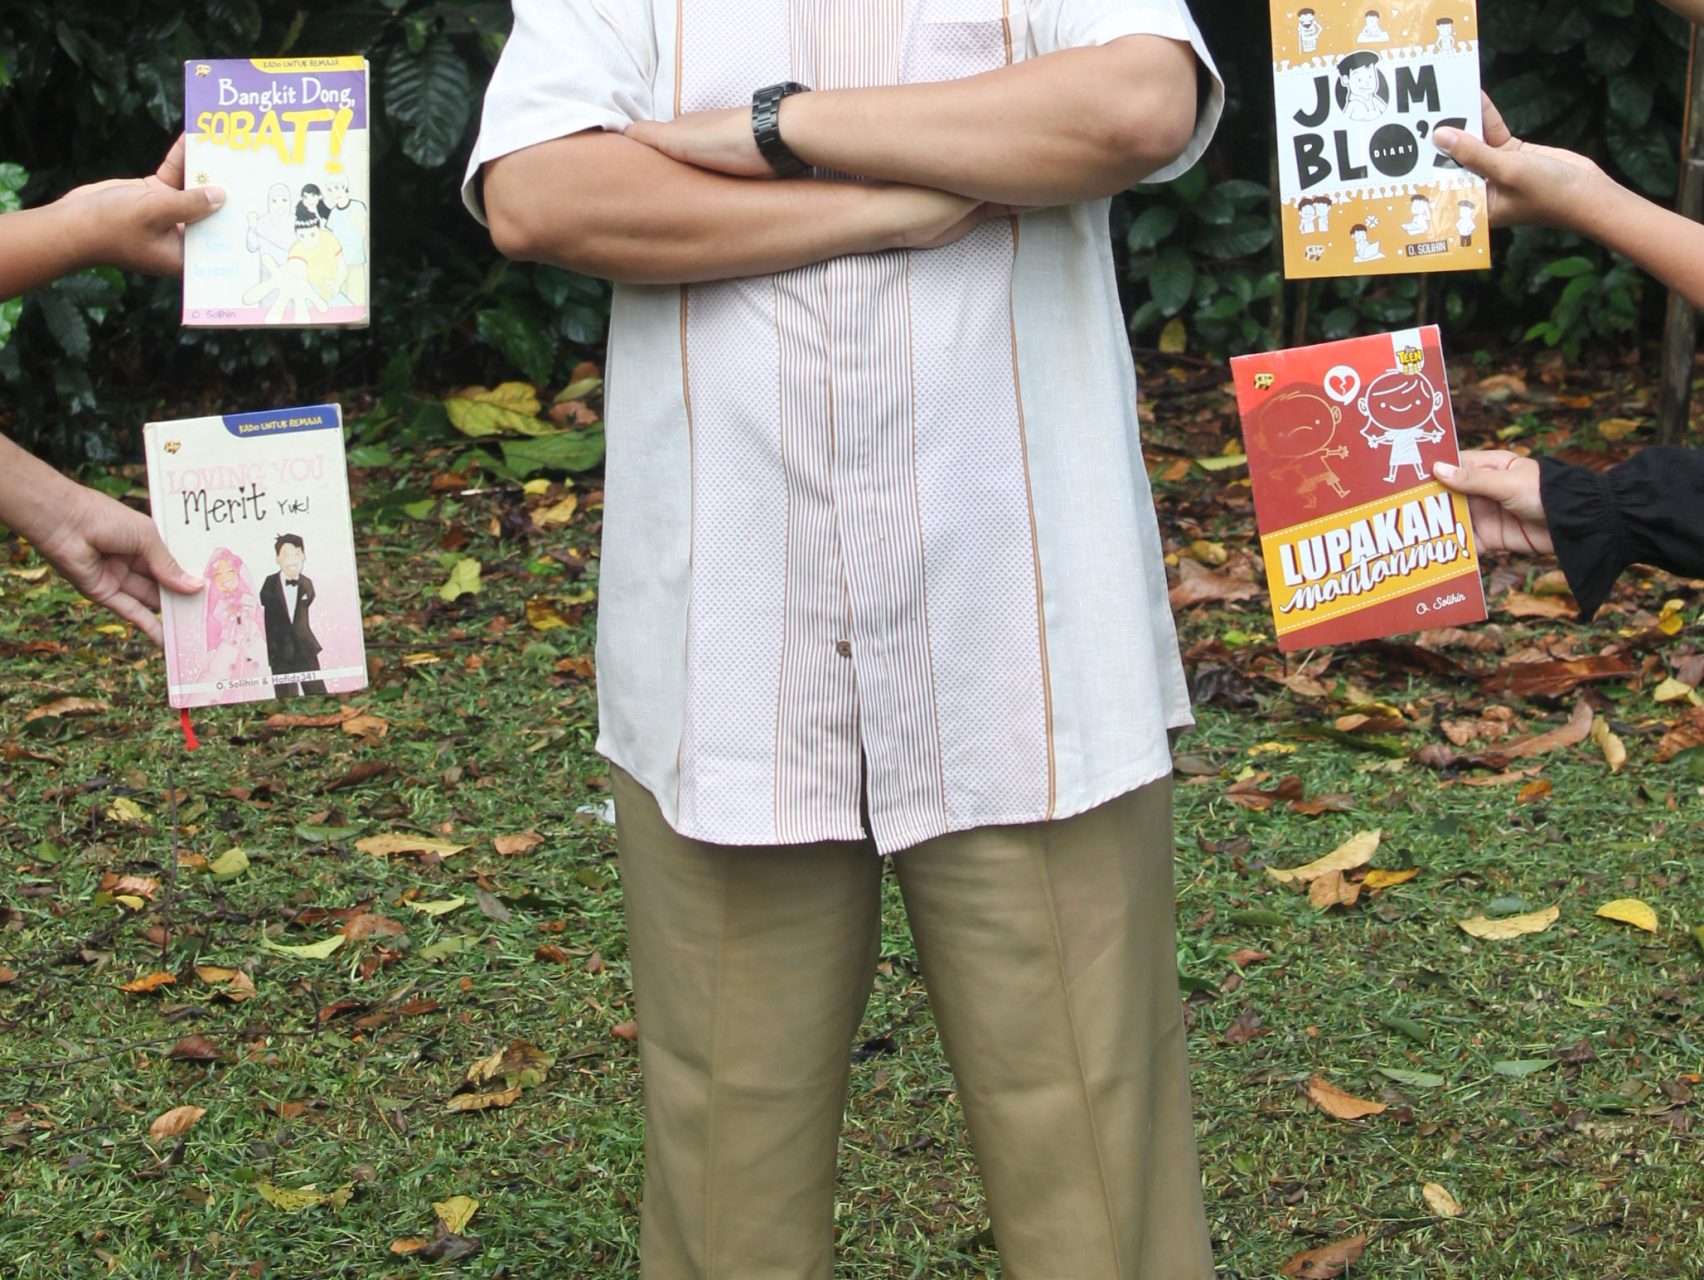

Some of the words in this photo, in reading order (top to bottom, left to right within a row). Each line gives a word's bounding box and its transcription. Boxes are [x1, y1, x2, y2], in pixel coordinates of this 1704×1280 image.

[218, 77, 296, 113] Bangkit
[302, 76, 356, 110] Dong,
[1373, 144, 1414, 158] DIARY
[1408, 245, 1417, 256] O.
[1418, 241, 1447, 254] SOLIHIN
[260, 421, 287, 431] UNTUK
[289, 416, 323, 428] REMAJA
[166, 461, 267, 495] LOVING
[271, 454, 325, 484] YOU
[182, 483, 267, 531] Merit
[1278, 492, 1456, 587] LUPAKAN
[1279, 522, 1471, 613] mantanmu!
[1433, 593, 1466, 610] Solihin
[229, 678, 260, 689] Solihin
[262, 677, 268, 685] &
